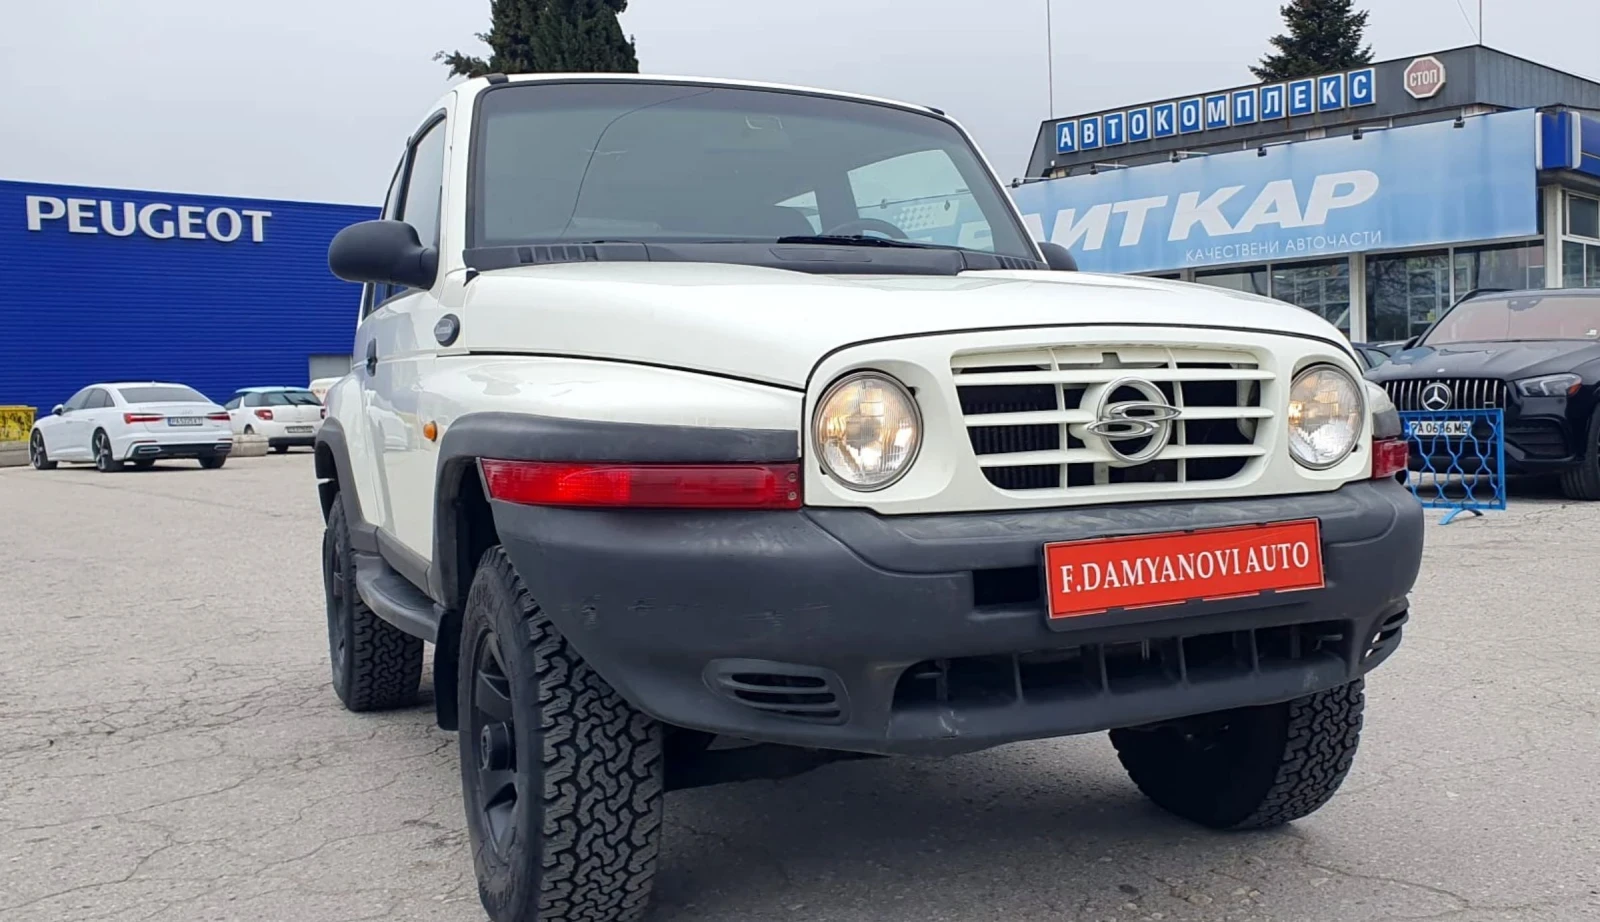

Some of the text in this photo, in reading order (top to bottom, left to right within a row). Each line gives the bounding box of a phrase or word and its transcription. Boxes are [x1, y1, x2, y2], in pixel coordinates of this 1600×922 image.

[1410, 69, 1438, 87] СТОП
[1060, 75, 1368, 148] АВТОКОМПЛЕКС
[26, 195, 273, 243] PEUGEOT
[1185, 230, 1382, 263] КАЧЕСТВЕНИ АВТОЧАСТИ
[1060, 541, 1310, 594] F.DAMYANOVI AUTO
